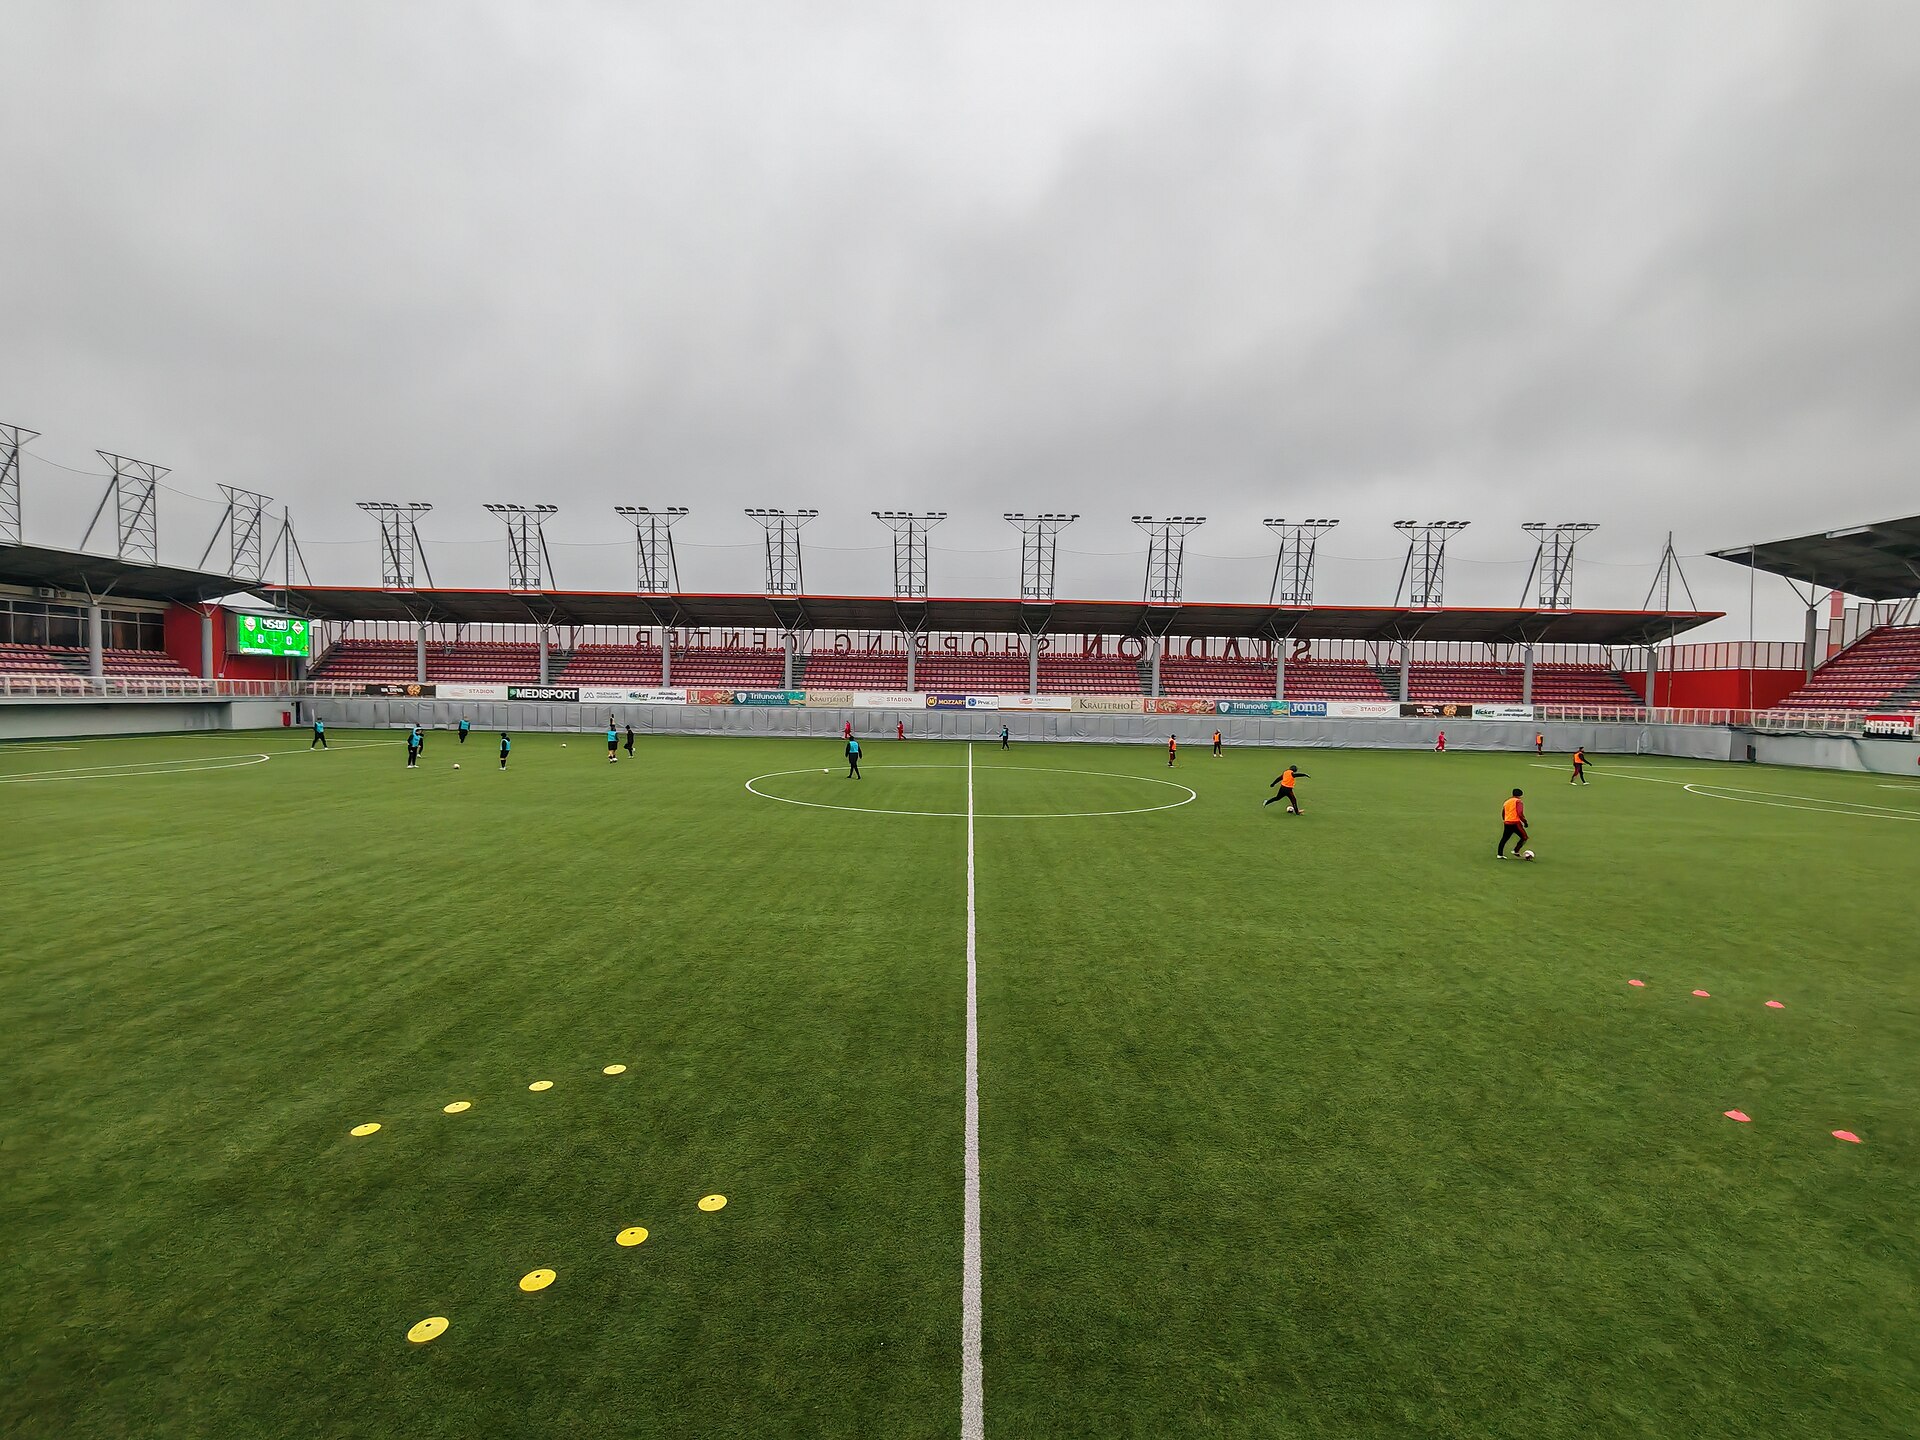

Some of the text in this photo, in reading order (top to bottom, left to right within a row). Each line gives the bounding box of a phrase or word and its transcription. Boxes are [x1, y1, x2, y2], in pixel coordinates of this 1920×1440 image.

[516, 688, 578, 700] MEDISPORT
[750, 692, 785, 700] Trifunović
[1232, 702, 1268, 710] Trifunović
